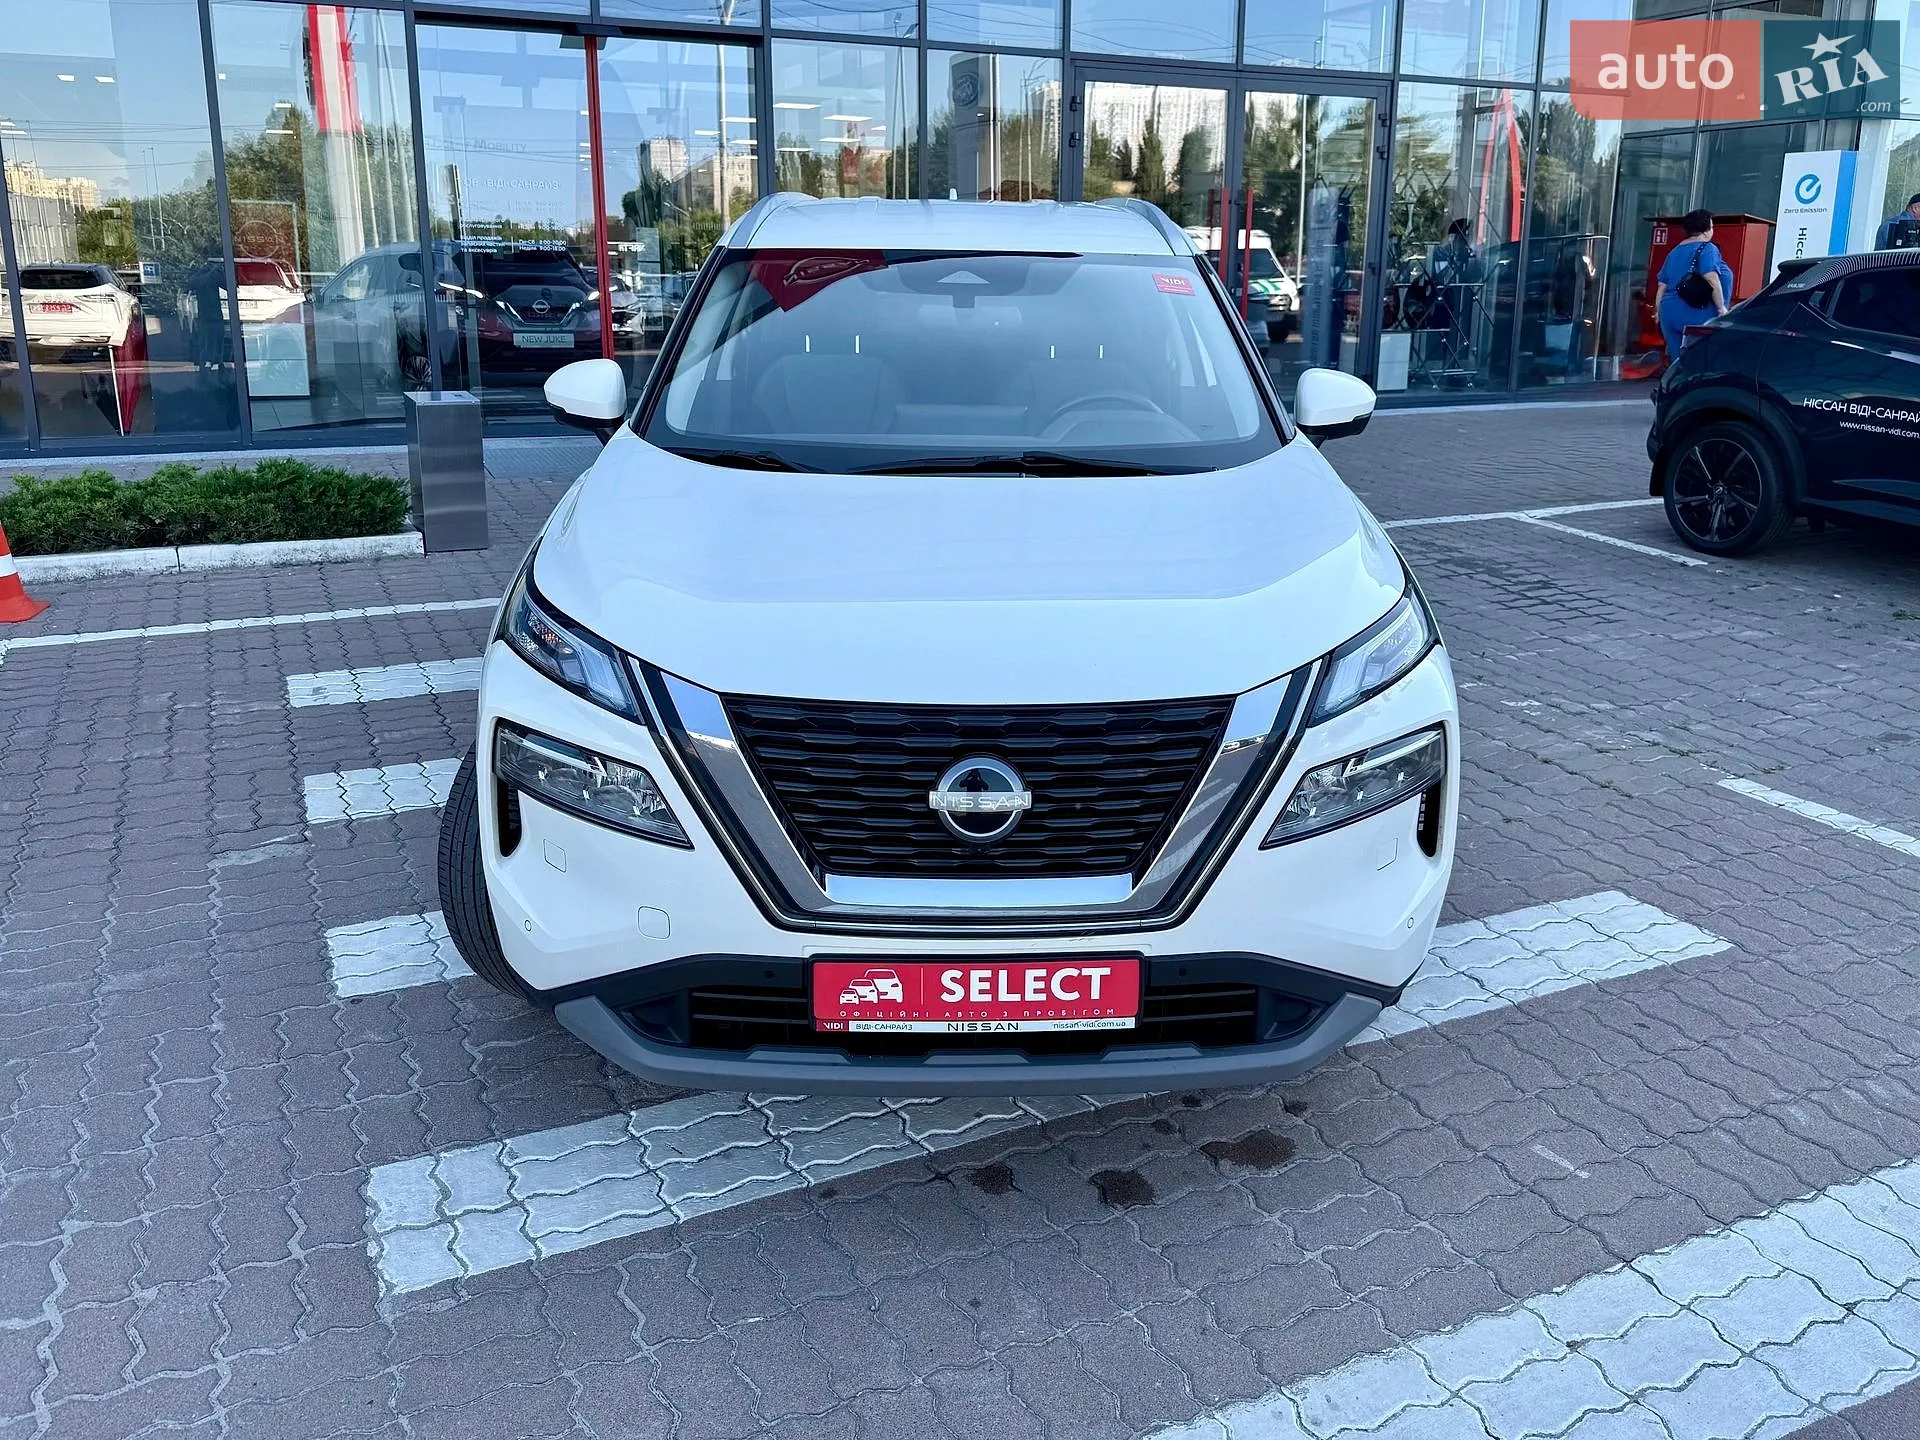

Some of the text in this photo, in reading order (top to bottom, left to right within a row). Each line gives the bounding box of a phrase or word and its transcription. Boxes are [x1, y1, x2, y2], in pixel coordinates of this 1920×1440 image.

[1795, 227, 1807, 260] Нісс
[521, 335, 542, 343] NEW
[1803, 397, 1848, 413] НІССАН
[932, 794, 1029, 810] NISSAN
[940, 967, 1111, 1003] SELECT
[839, 1010, 930, 1018] ОФІЦІЙНІ
[944, 1010, 989, 1018] АВТО
[1023, 1008, 1115, 1017] ПРОБІГОМ
[823, 1022, 844, 1030] VIDI
[855, 1023, 913, 1031] ВІДІ-САНРАЙЗ
[947, 1022, 1020, 1032] NISSAN
[1053, 1020, 1126, 1030] nissan-vidi.com.ua
